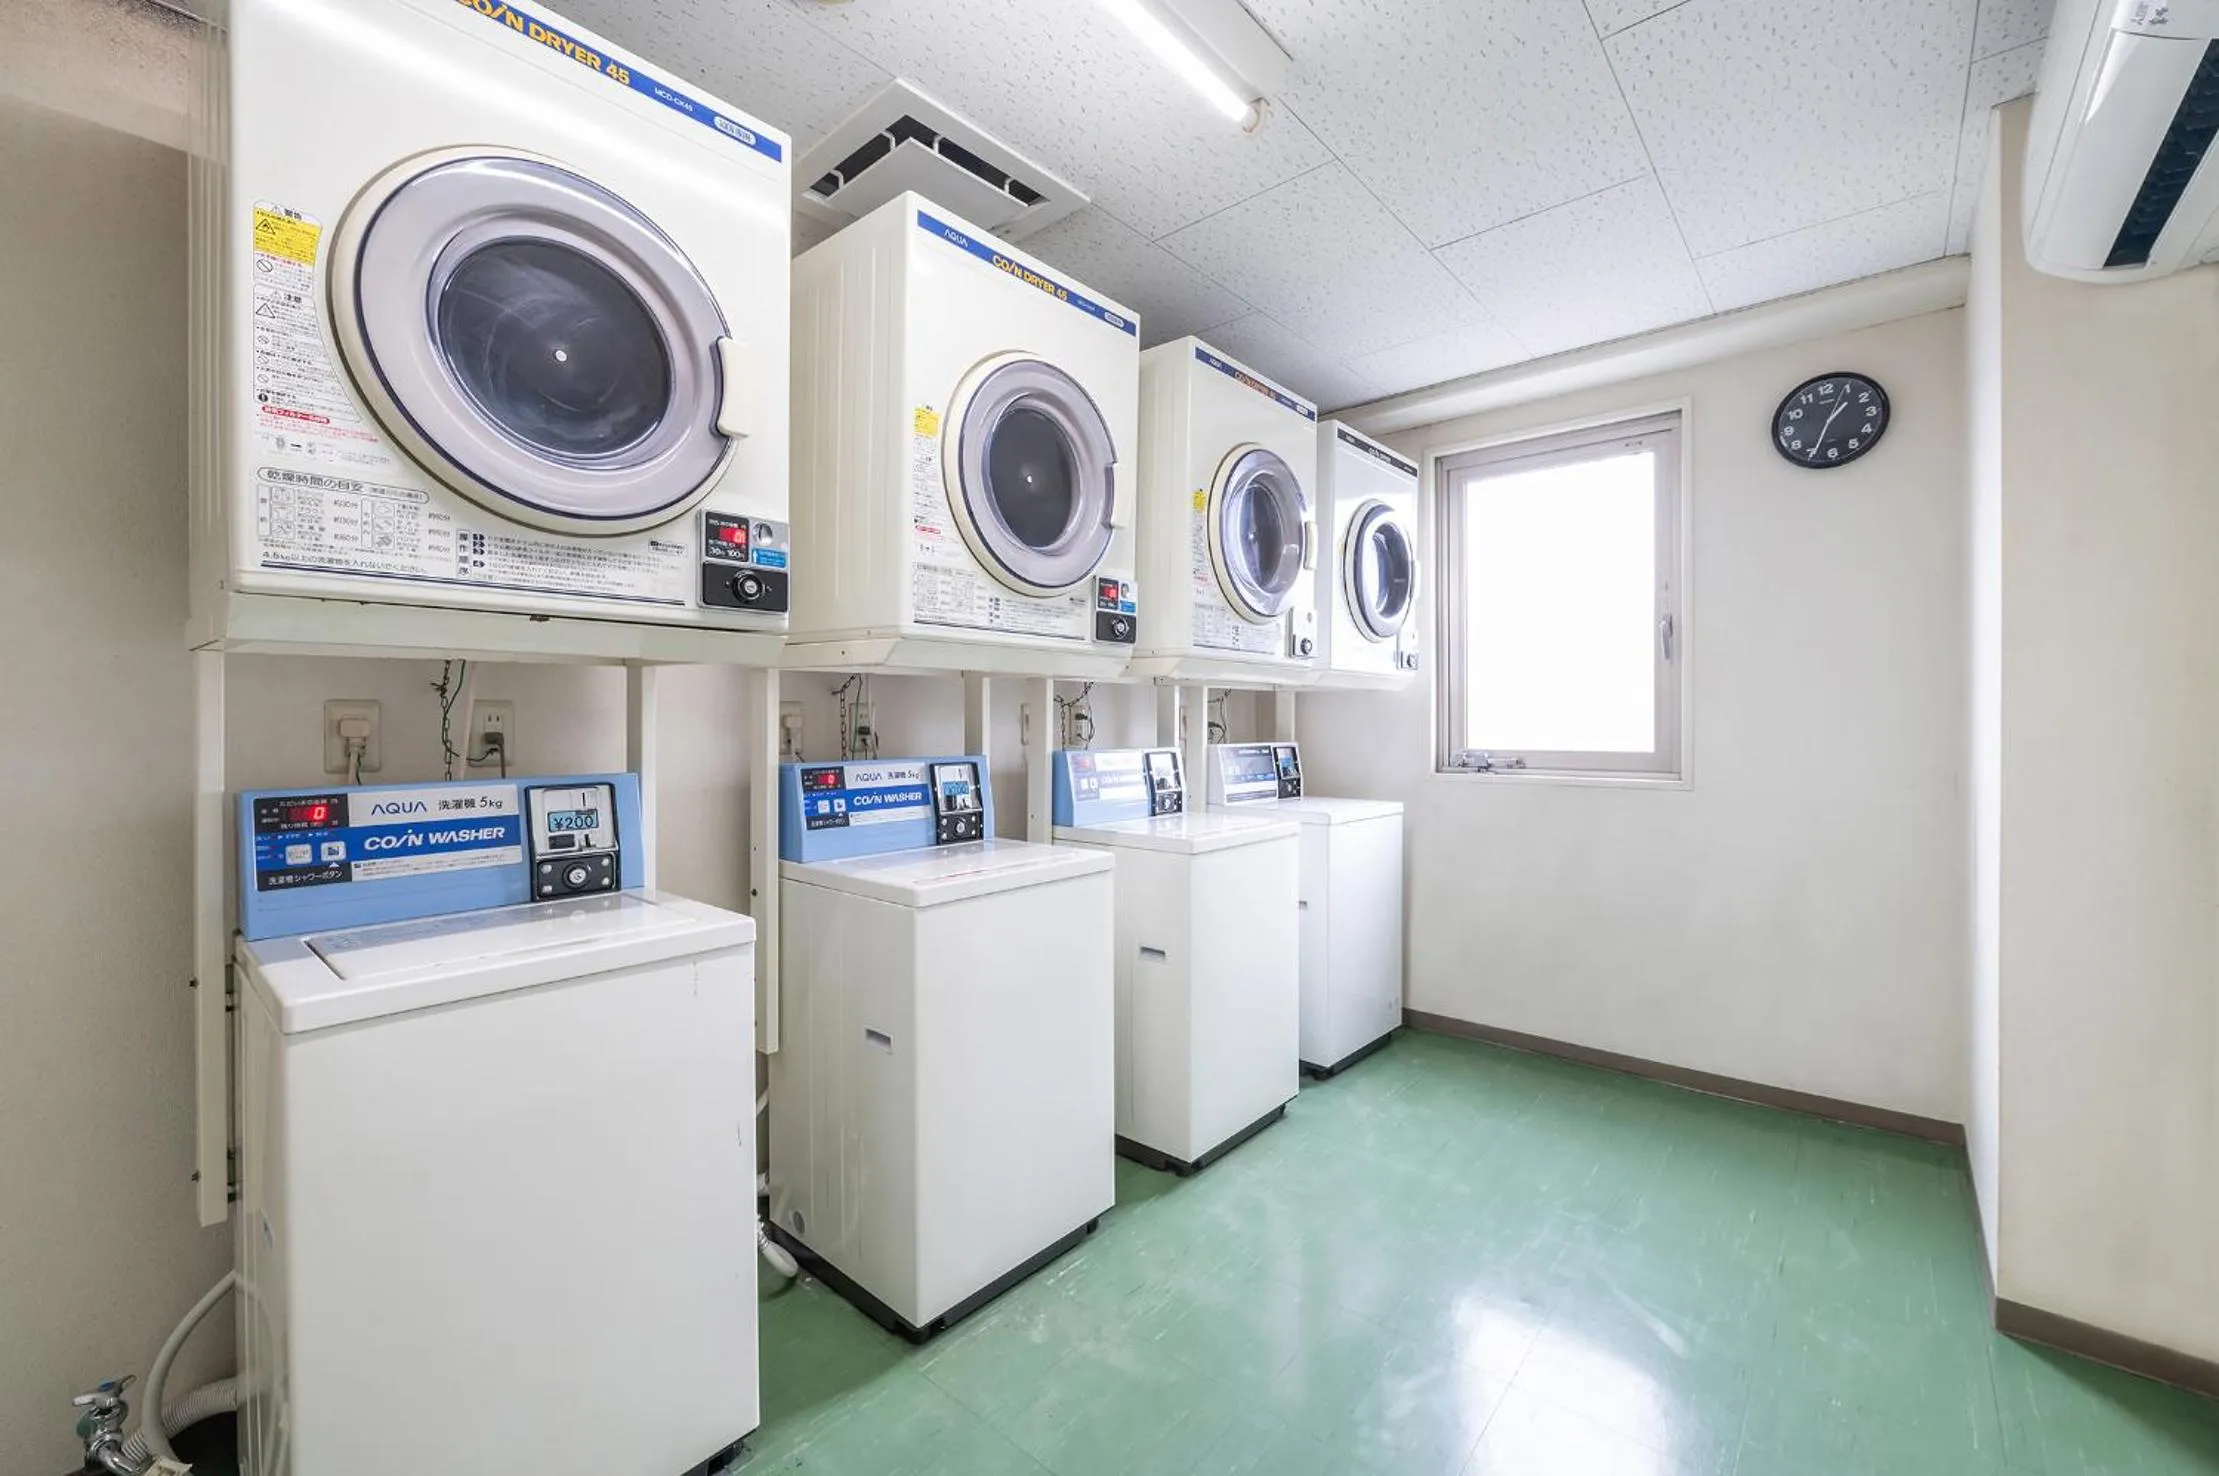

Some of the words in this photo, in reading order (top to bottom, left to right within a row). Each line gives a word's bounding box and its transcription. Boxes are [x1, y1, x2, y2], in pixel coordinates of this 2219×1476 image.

[529, 22, 601, 72] DRYER
[606, 63, 630, 85] 45
[943, 229, 968, 248] AQUA
[1023, 272, 1055, 297] DRYER
[1818, 383, 1834, 395] 12
[1844, 384, 1851, 393] 1
[1800, 393, 1814, 405] 11
[1858, 391, 1869, 403] 2
[1788, 408, 1803, 420] 10
[1865, 406, 1877, 416] 3
[1783, 426, 1794, 436] 9
[1861, 423, 1872, 433] 4
[1791, 440, 1802, 450] 8
[1848, 438, 1859, 449] 5
[1806, 447, 1817, 458] 7
[1827, 448, 1838, 458] 6
[855, 772, 882, 782] AQUA
[883, 792, 922, 803] WASHER
[371, 801, 428, 816] AQUA
[438, 799, 476, 811] 洗濯機
[479, 796, 503, 810] 5kg
[314, 806, 327, 820] 0
[553, 814, 595, 831] ¥200
[428, 826, 506, 845] WASHER
